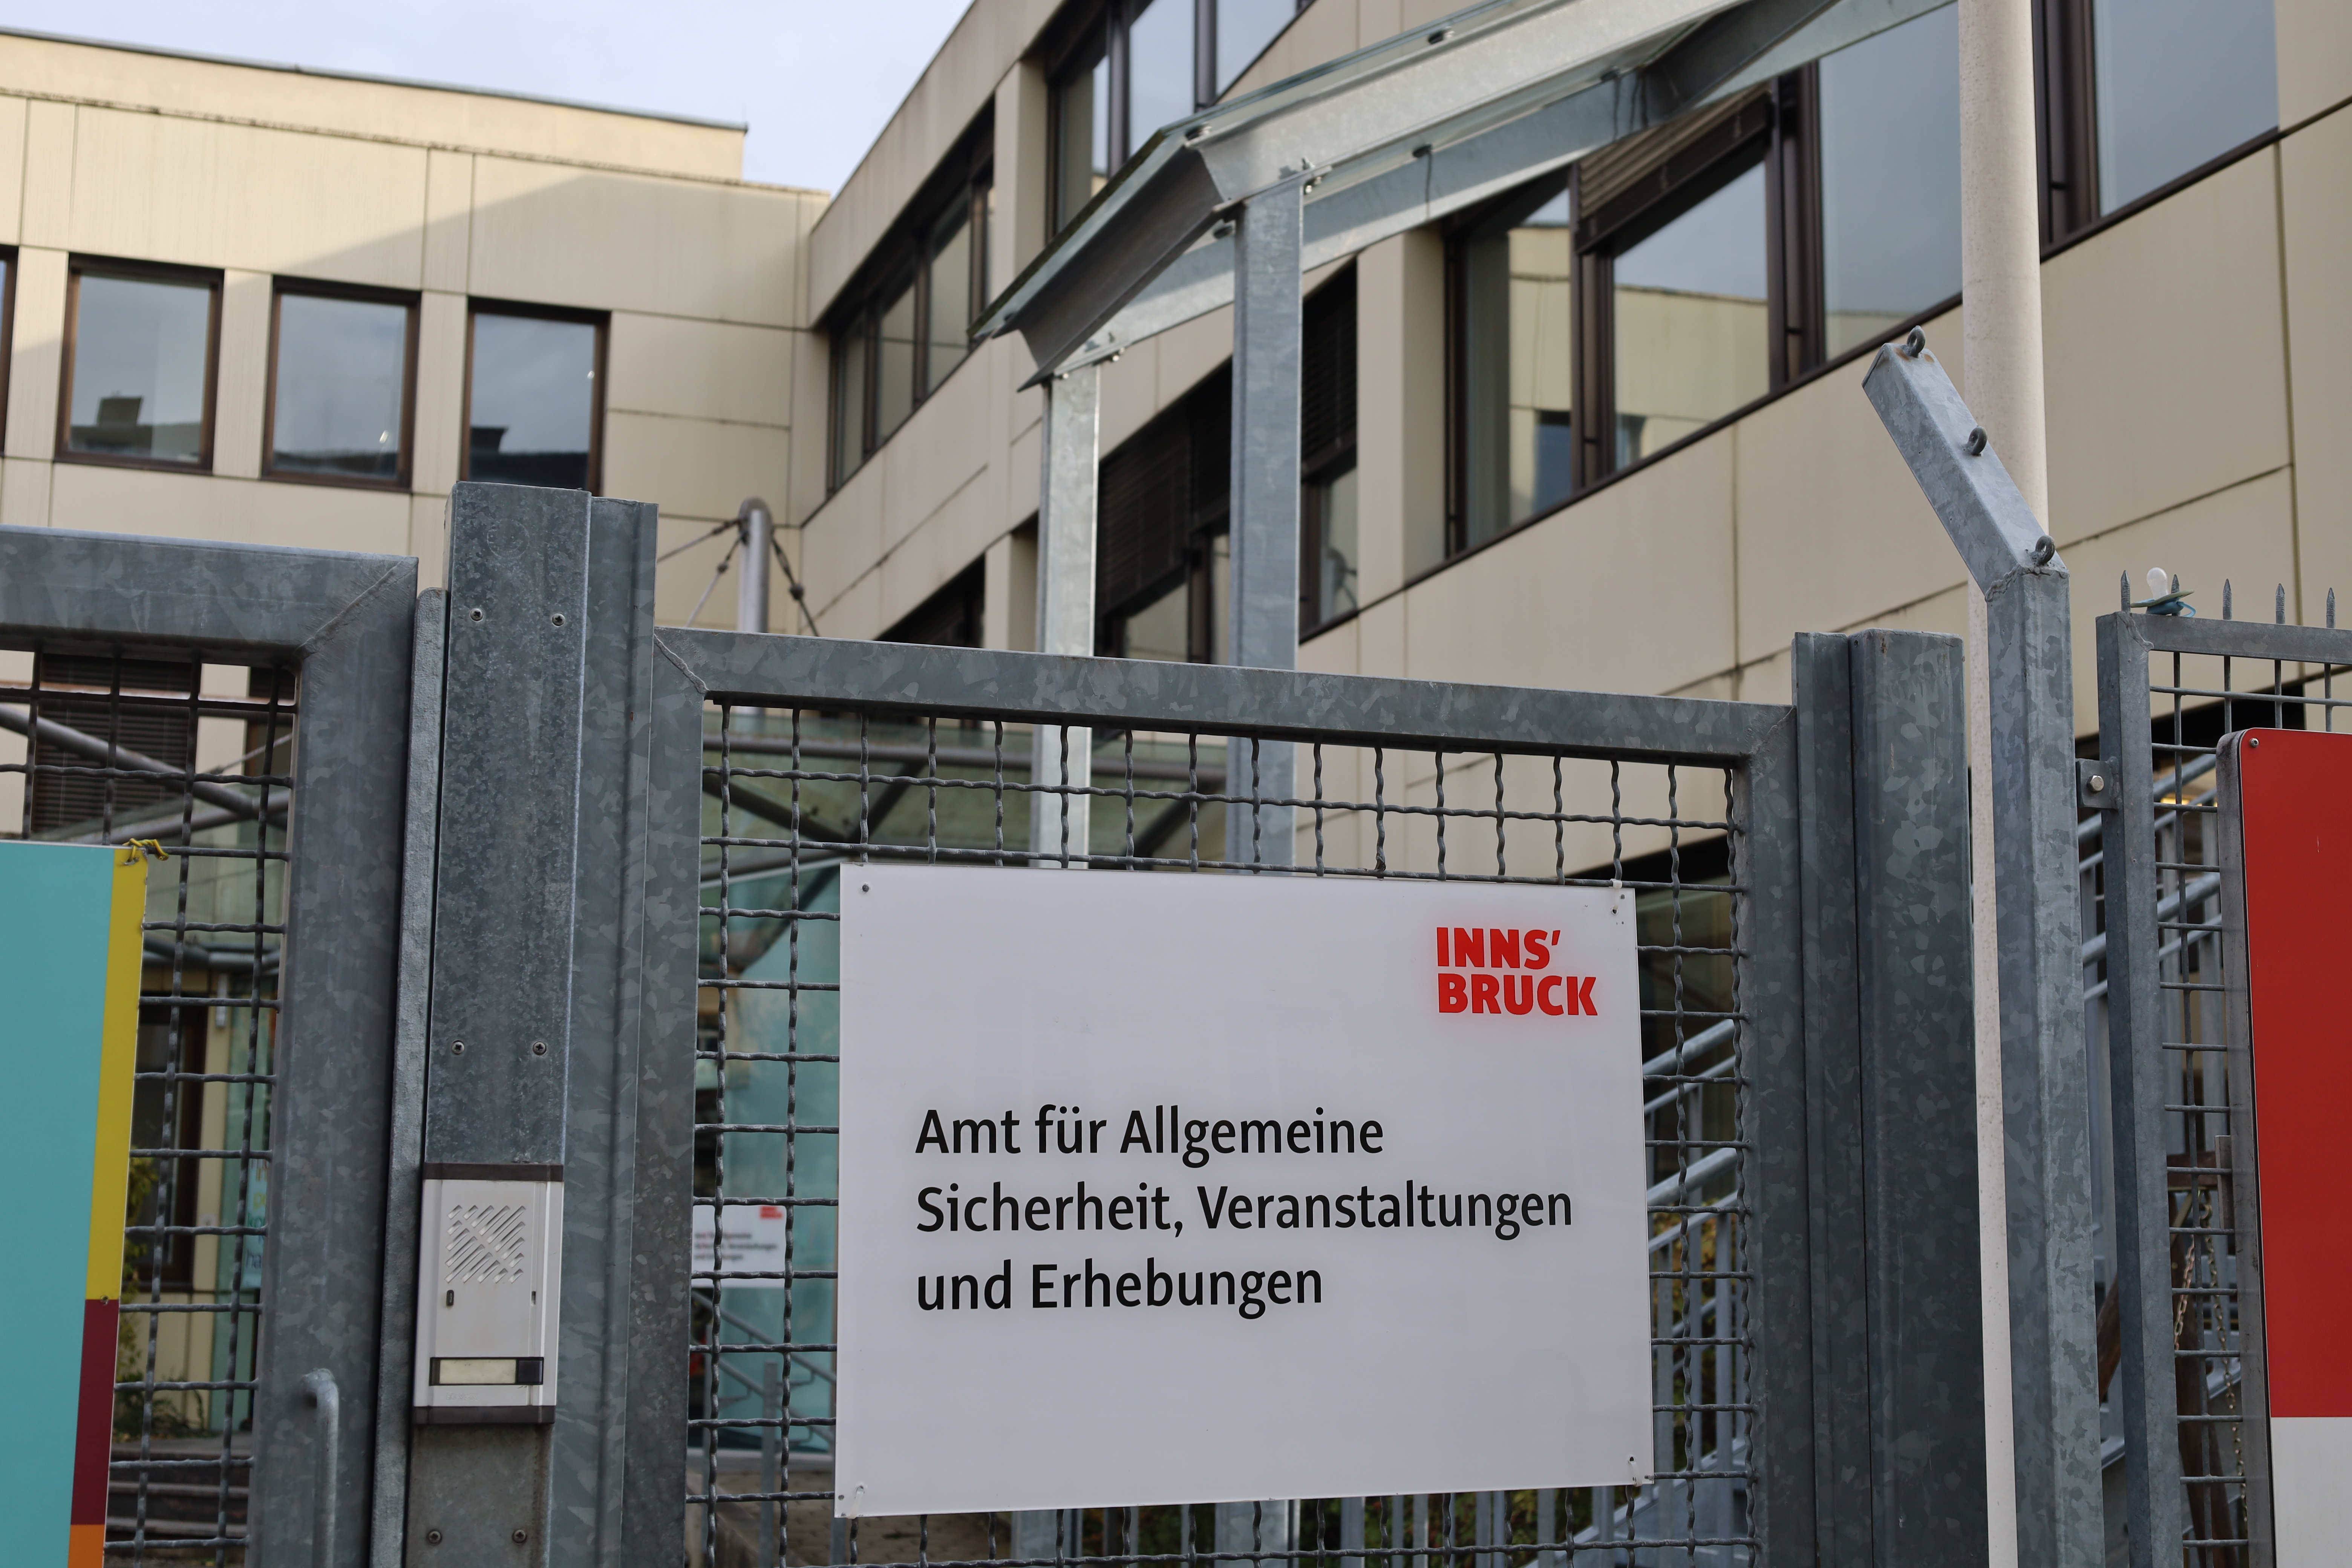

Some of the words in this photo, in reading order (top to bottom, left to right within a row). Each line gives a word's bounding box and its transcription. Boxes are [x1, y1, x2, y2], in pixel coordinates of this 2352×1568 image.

[1438, 973, 1598, 1016] BRUCK
[915, 1110, 1021, 1154] Amt
[1034, 1104, 1107, 1154] für
[1119, 1104, 1383, 1168] Allgemeine
[916, 1181, 1183, 1238] Sicherheit,
[1196, 1179, 1572, 1241] Veranstaltungen
[918, 1259, 1011, 1311] und
[1032, 1257, 1321, 1320] Erhebungen
